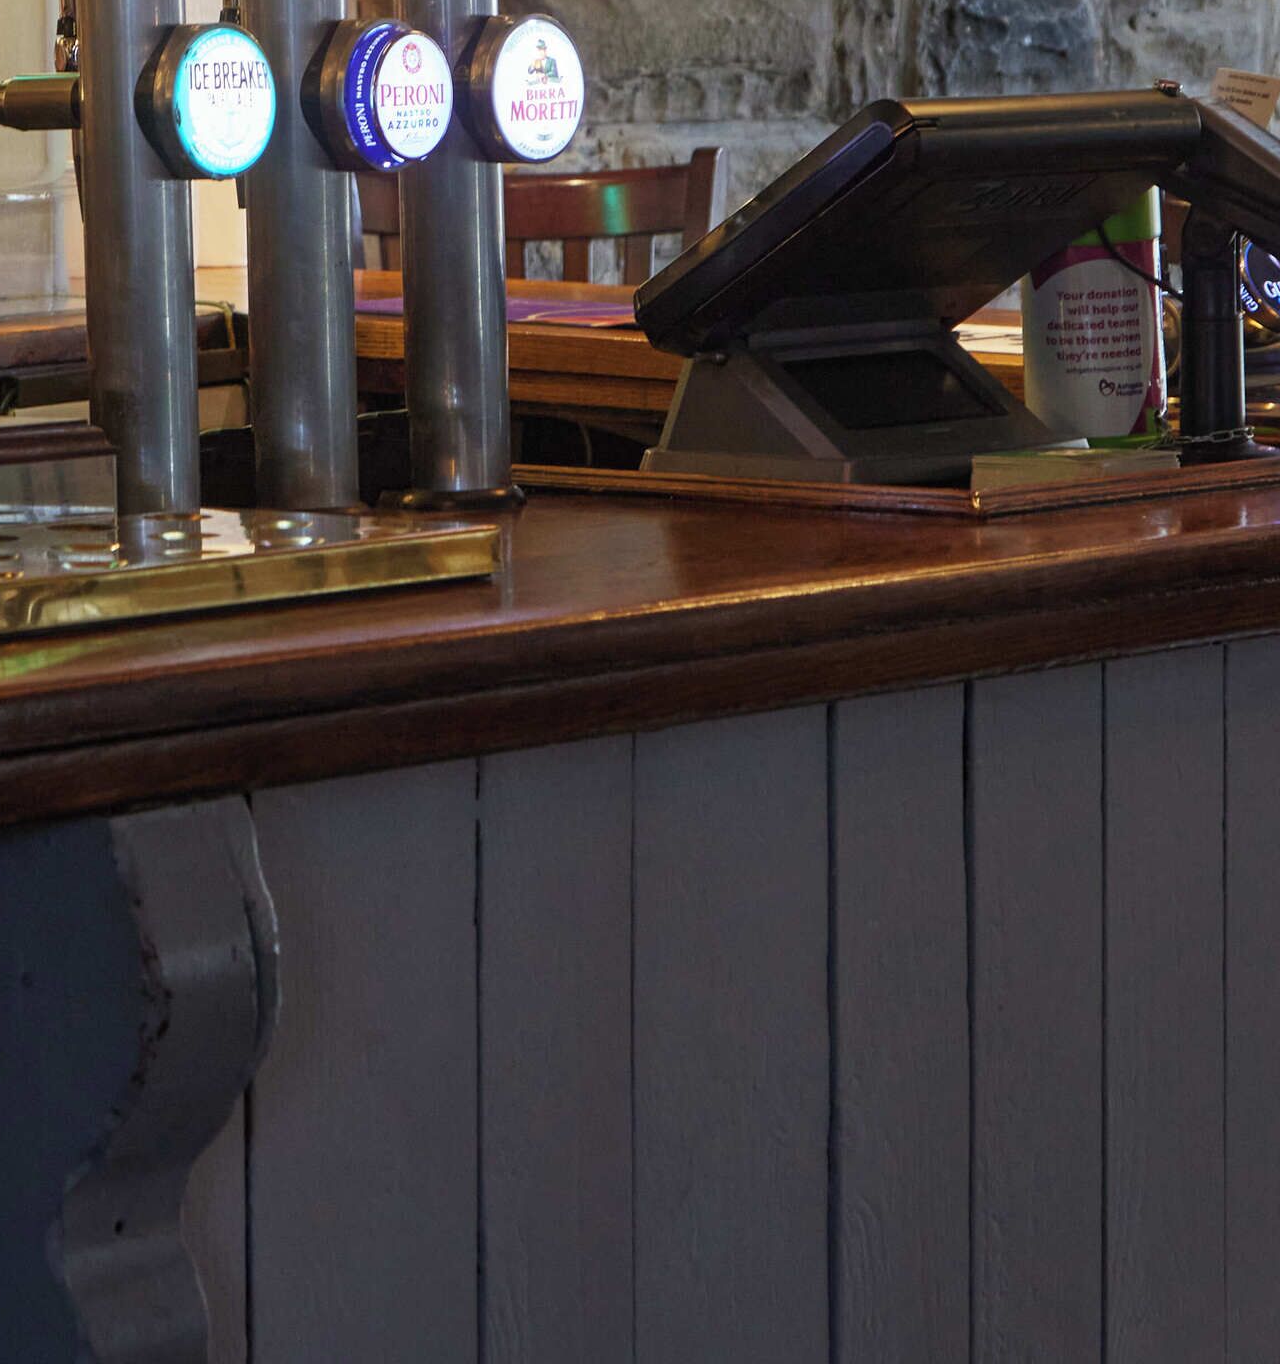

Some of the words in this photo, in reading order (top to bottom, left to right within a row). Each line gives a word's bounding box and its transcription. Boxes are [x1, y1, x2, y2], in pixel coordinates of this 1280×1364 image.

[189, 62, 210, 90] ICE
[213, 60, 271, 89] BREAKER
[380, 83, 444, 107] PERONI
[526, 87, 566, 101] BIRRA
[510, 100, 578, 122] MORETTI
[355, 103, 377, 147] PERONI
[387, 118, 439, 130] AZZURRO
[1057, 291, 1084, 301] Your
[1087, 288, 1138, 300] donation
[1068, 305, 1090, 315] will
[1092, 303, 1118, 316] help
[1121, 303, 1139, 312] our
[1047, 319, 1105, 331] dedicated
[1108, 318, 1140, 328] teams
[1046, 336, 1058, 345] to
[1060, 336, 1075, 345] be
[1076, 334, 1109, 346] there
[1112, 333, 1141, 343] when
[1056, 351, 1099, 362] they're
[1101, 347, 1142, 360] needed
